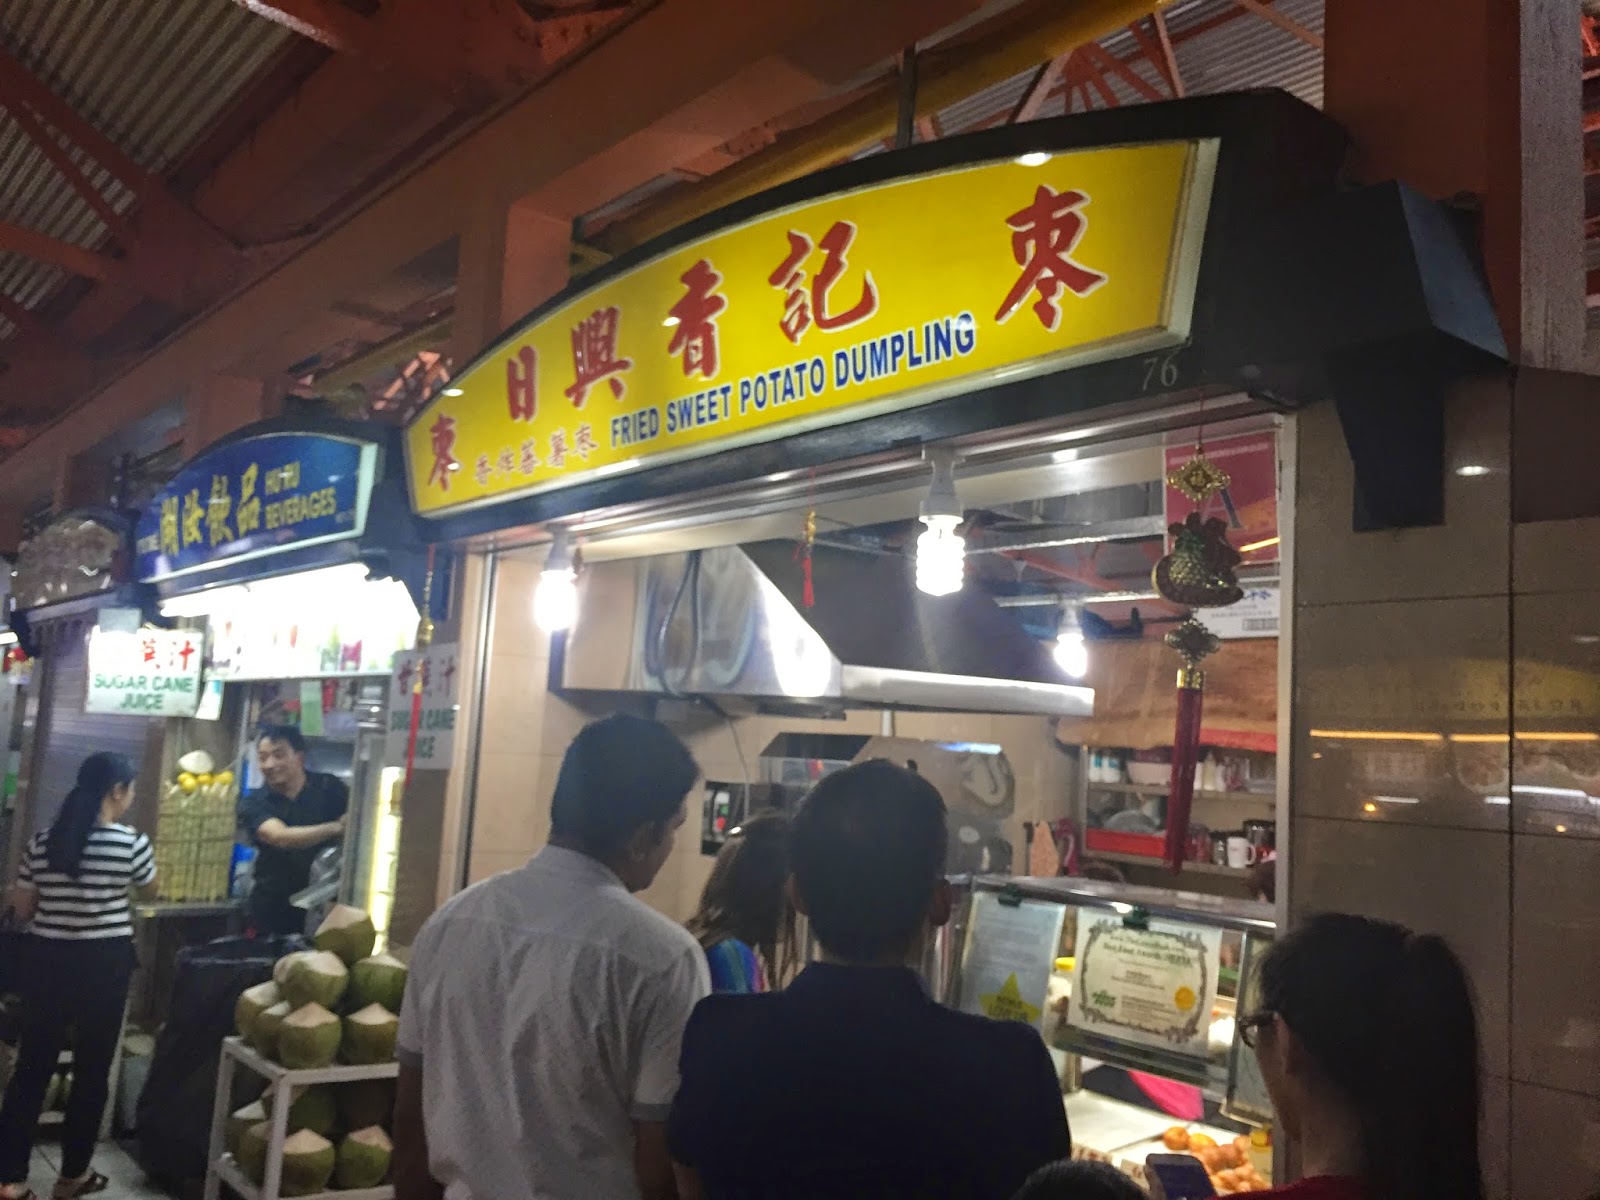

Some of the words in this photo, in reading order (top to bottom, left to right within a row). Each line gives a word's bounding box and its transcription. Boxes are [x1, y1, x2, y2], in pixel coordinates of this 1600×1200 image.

[611, 406, 661, 448] FRIED
[666, 384, 732, 434] SWEET
[740, 357, 826, 414] POTATO
[834, 312, 976, 388] DUMPLING
[1142, 349, 1180, 391] 76
[94, 673, 148, 691] SUGAR
[151, 675, 194, 693] CANE
[120, 692, 164, 710] JUICE
